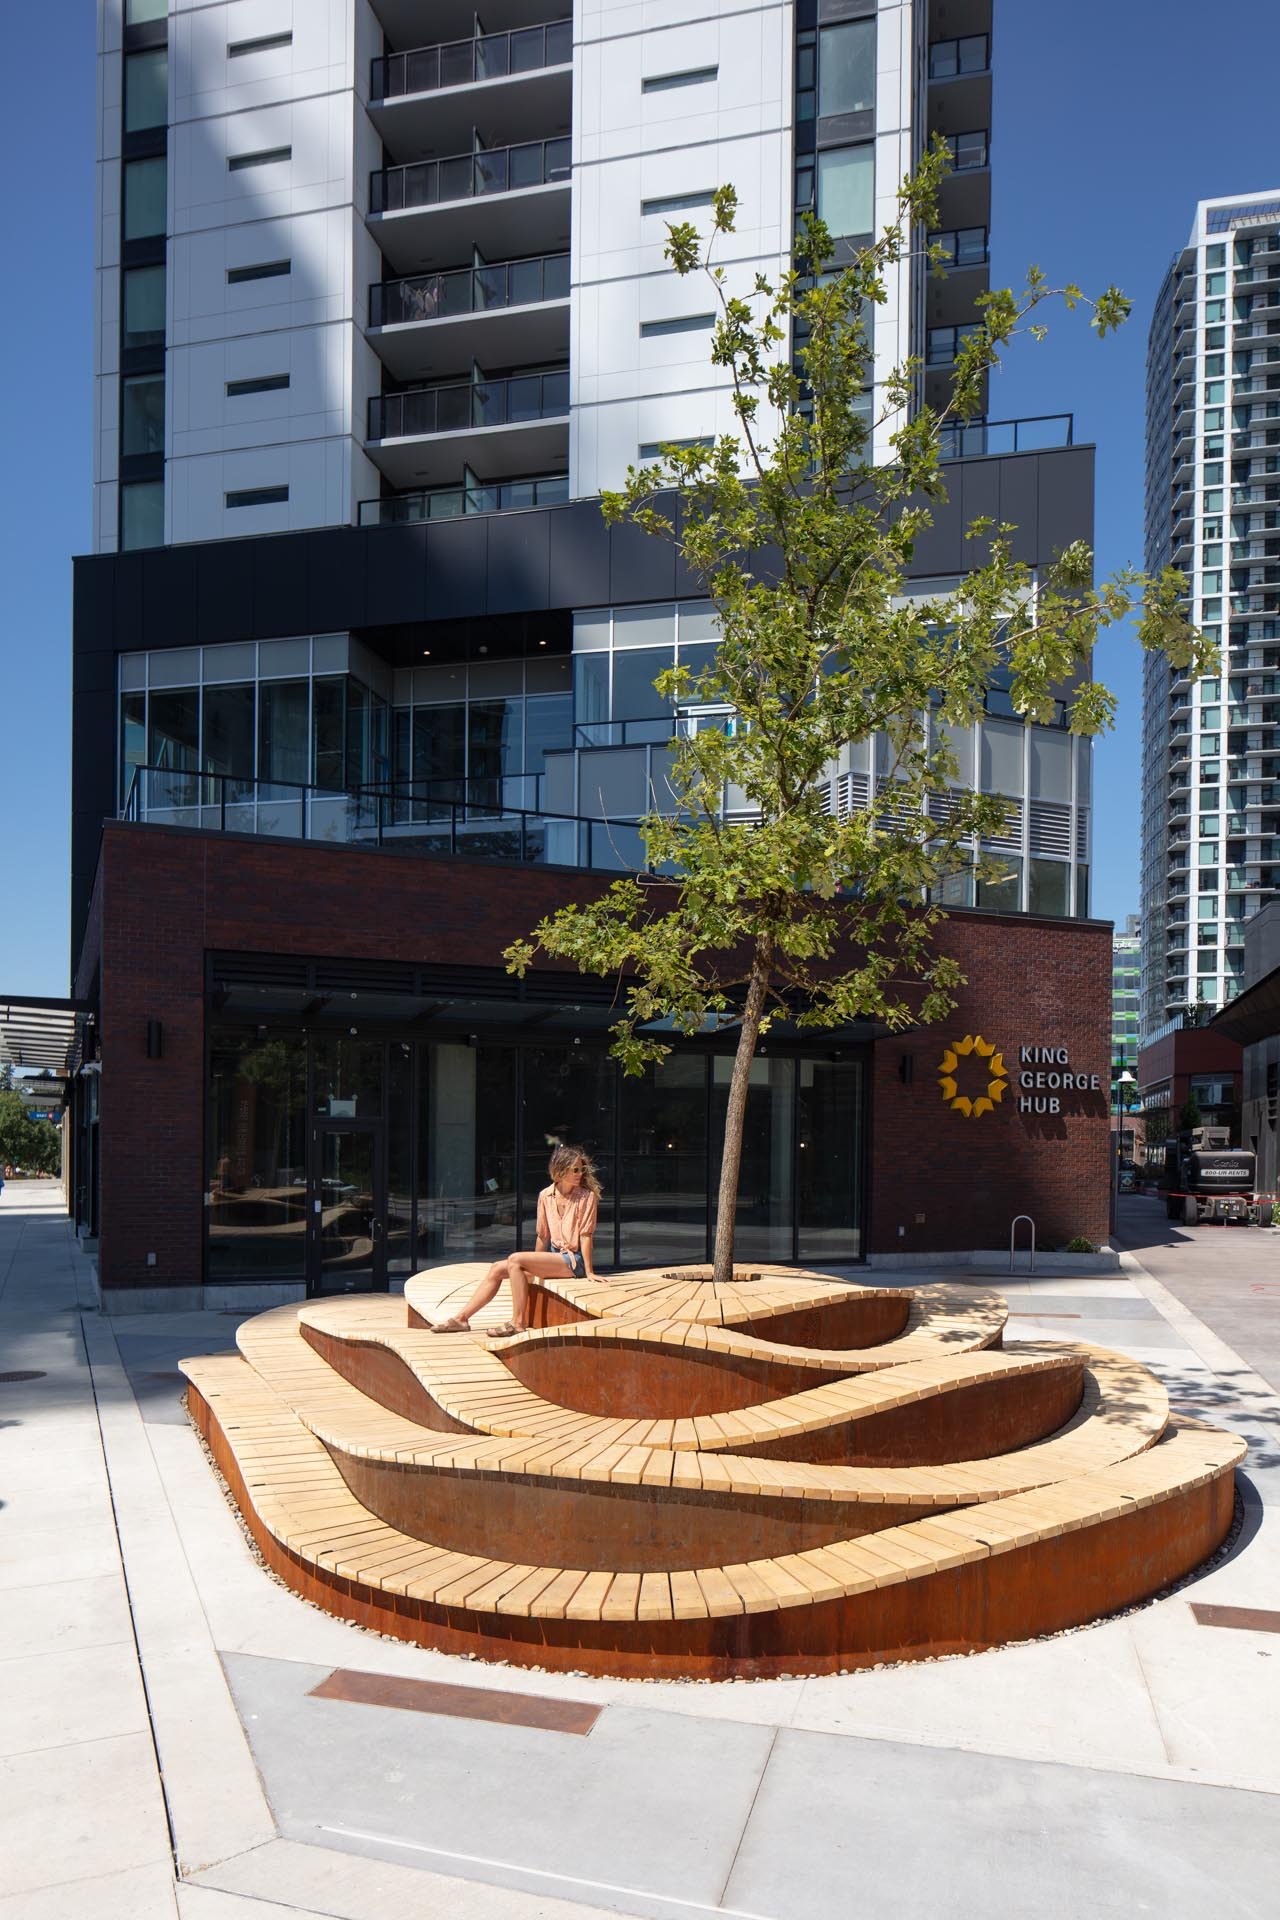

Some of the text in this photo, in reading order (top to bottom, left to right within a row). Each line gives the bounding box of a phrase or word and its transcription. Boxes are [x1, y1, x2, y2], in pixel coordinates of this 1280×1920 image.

[1021, 1046, 1068, 1065] KING
[1021, 1070, 1100, 1090] GEORGE
[1020, 1095, 1061, 1114] HUB
